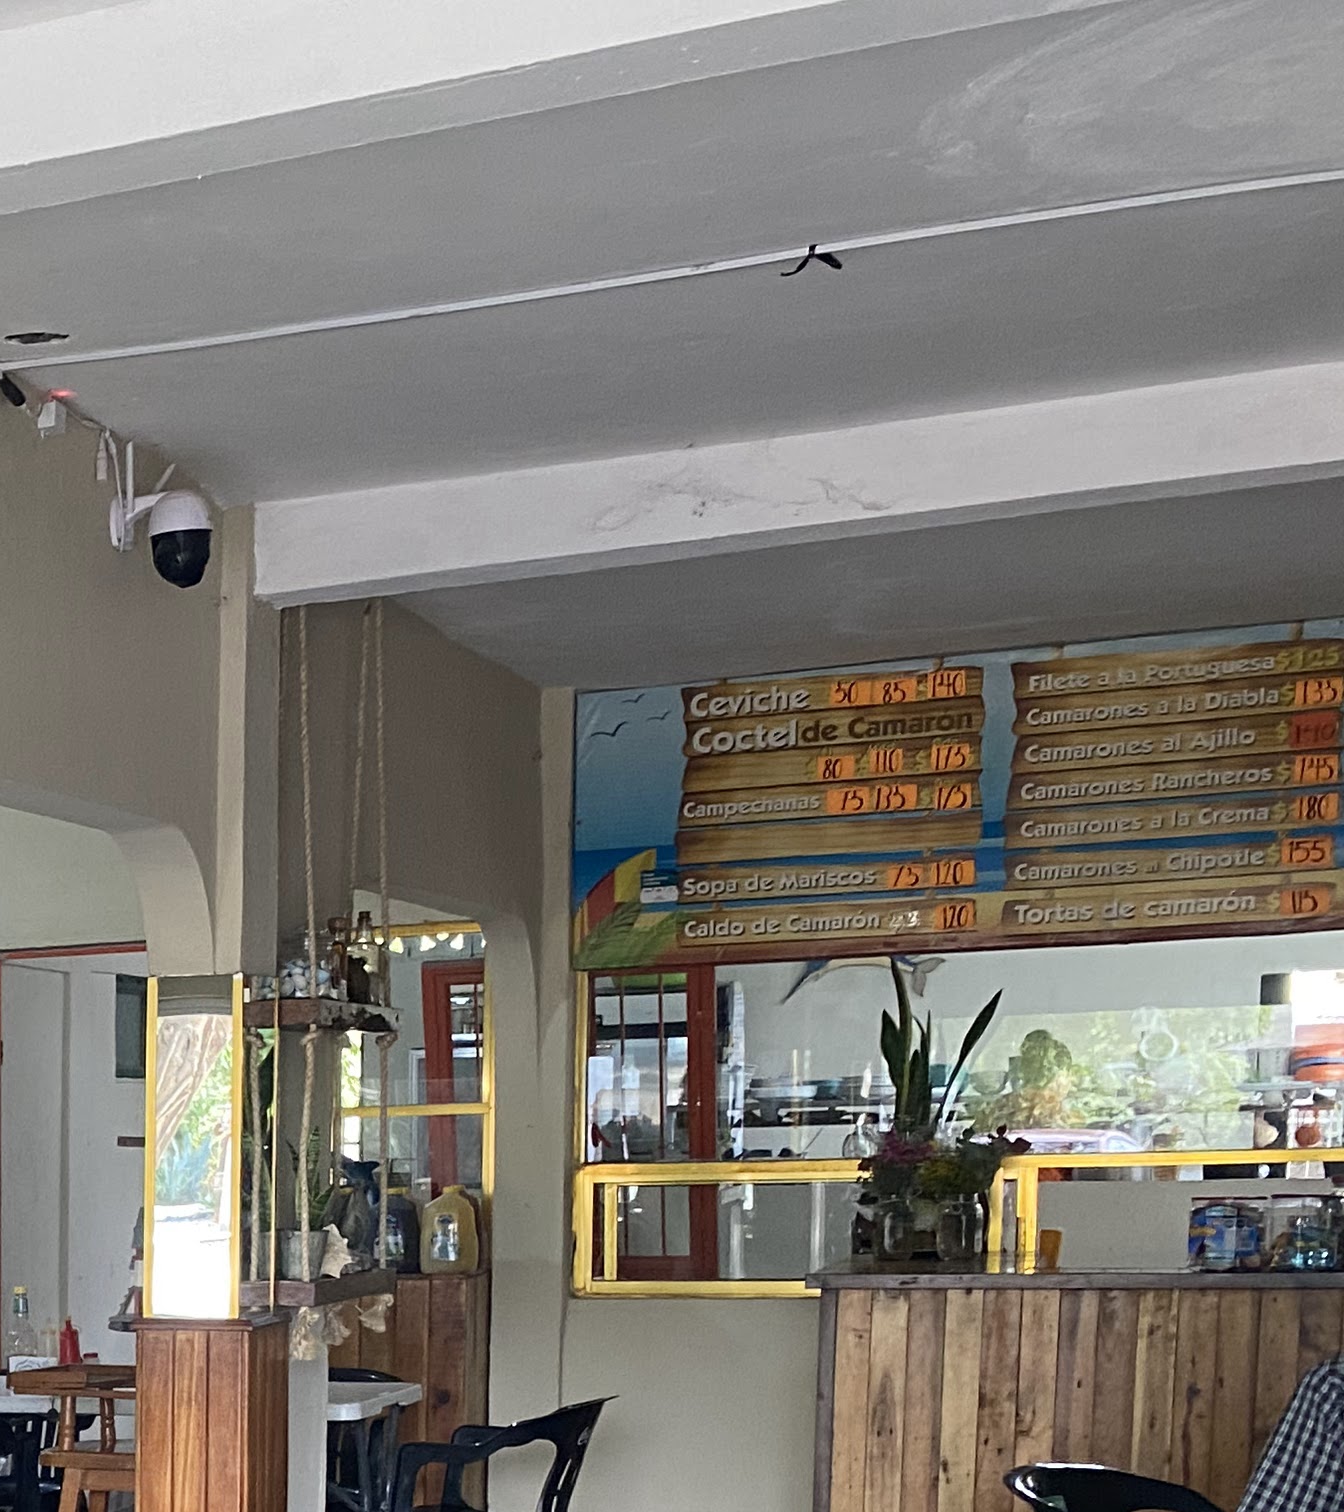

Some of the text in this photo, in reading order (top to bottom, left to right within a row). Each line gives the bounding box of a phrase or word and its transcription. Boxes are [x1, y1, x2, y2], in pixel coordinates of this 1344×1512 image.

[1029, 671, 1090, 692] Filete
[1097, 671, 1111, 686] a
[1116, 666, 1137, 686] la
[1143, 654, 1276, 683] Portuguesa
[690, 684, 810, 718] Ceviche
[883, 682, 907, 704] 85
[1026, 699, 1149, 726] Camarones
[1155, 701, 1170, 716] a
[1177, 693, 1196, 713] la
[1204, 685, 1280, 711] Diabla
[692, 718, 799, 754] Coctel
[800, 718, 839, 744] de
[1024, 736, 1153, 764] Camarones
[1162, 732, 1182, 752] al
[1188, 728, 1257, 752] Ajillo
[1020, 775, 1145, 802] Camarones
[1151, 766, 1273, 791] Rancheros
[683, 795, 820, 821] Campechanas
[1020, 813, 1143, 839] Camarones
[1150, 815, 1162, 830] a
[1171, 810, 1190, 827] la
[1198, 805, 1270, 824] Crema
[1014, 860, 1137, 881] Camarones
[1165, 849, 1265, 873] Chipotle
[683, 877, 739, 898] Sopa
[745, 875, 774, 891] de
[779, 870, 877, 891] Mariscos
[684, 917, 745, 938] Caldo
[752, 916, 780, 934] de
[786, 911, 881, 933] Camarón
[1014, 902, 1094, 925] Tortas
[1101, 899, 1135, 919] de
[1143, 890, 1257, 917] camarón
